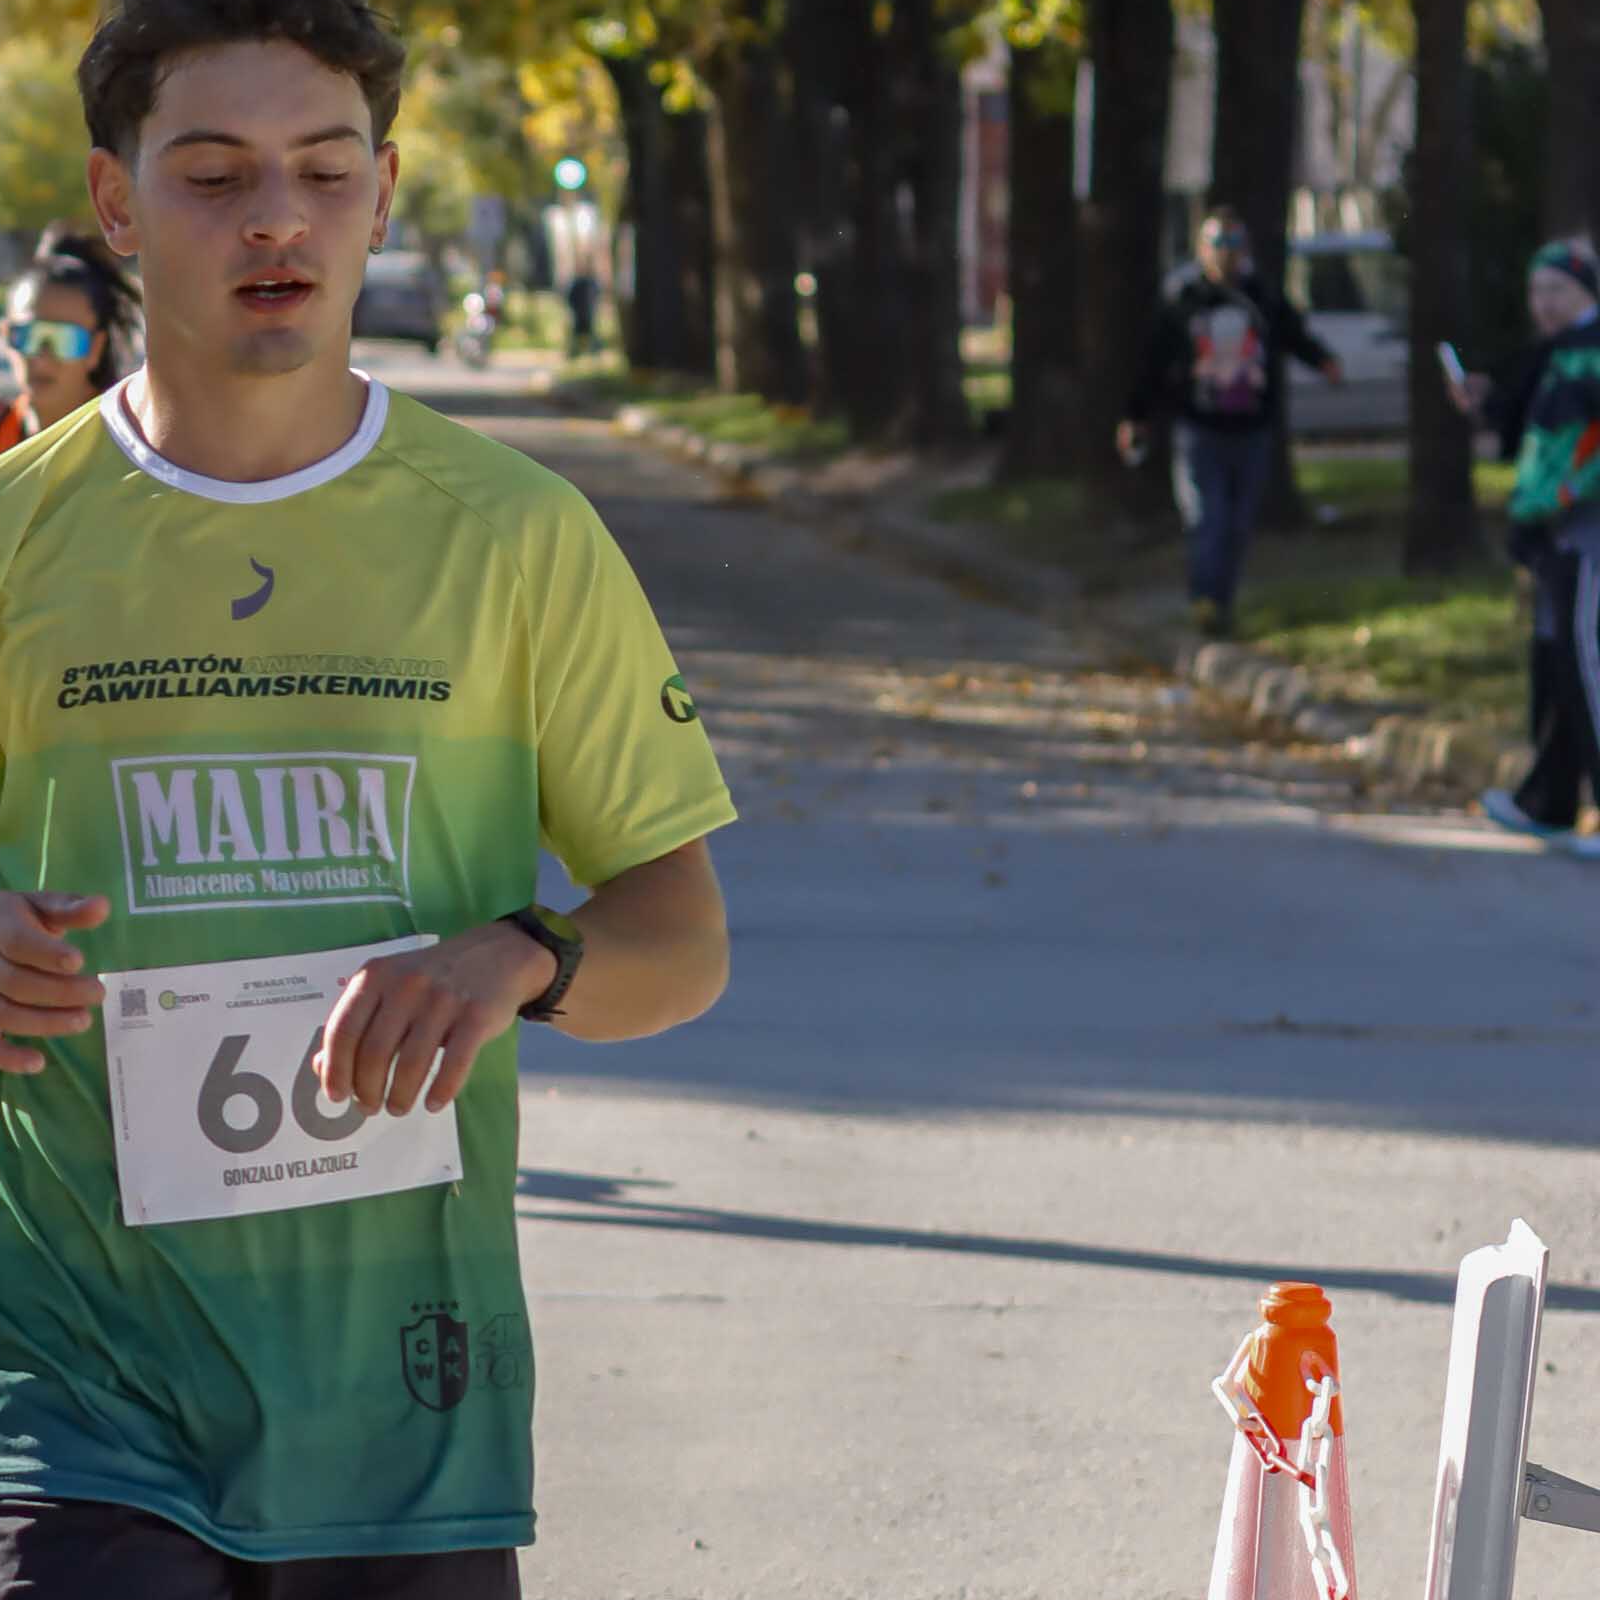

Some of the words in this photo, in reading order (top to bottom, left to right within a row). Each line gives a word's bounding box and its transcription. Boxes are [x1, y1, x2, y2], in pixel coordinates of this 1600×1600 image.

[57, 675, 451, 709] CAWILLIAMSKEMMIS
[131, 766, 396, 866] MAIRA
[144, 870, 256, 899] Almacenes
[262, 865, 369, 897] Mayoristas
[223, 1162, 285, 1187] GONZALO
[286, 1152, 360, 1178] VELAZQUEZ
